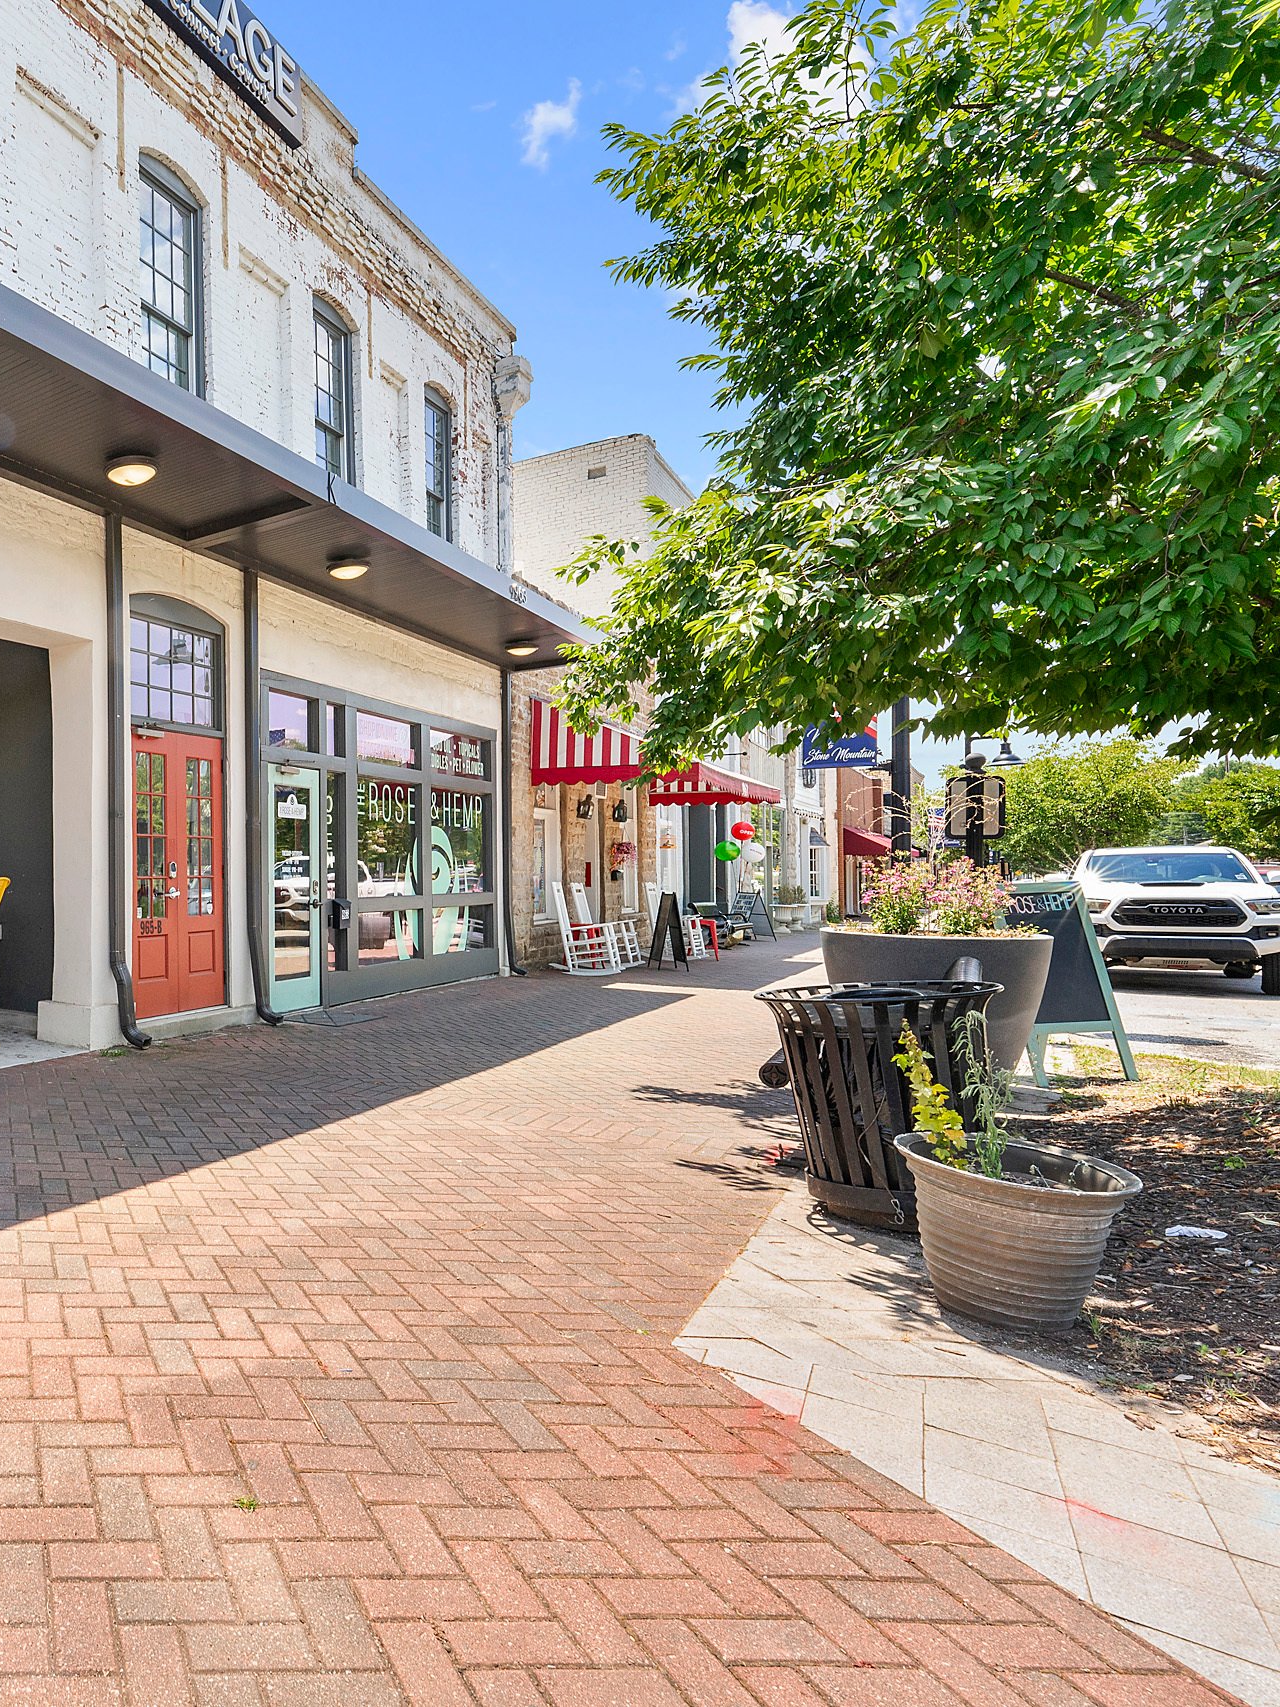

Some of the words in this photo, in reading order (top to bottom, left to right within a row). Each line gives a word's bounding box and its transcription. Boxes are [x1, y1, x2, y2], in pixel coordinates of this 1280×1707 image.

[458, 741, 479, 759] TOPICALS
[803, 748, 830, 765] Stone
[831, 746, 876, 762] Mountain
[453, 757, 461, 773] PET
[466, 760, 483, 776] FLOWER
[357, 783, 366, 815] THE
[368, 782, 416, 825] ROSE
[430, 791, 439, 820] &
[442, 791, 483, 829] HEMP
[1042, 893, 1074, 912] HEMP
[140, 920, 162, 935] 965-B
